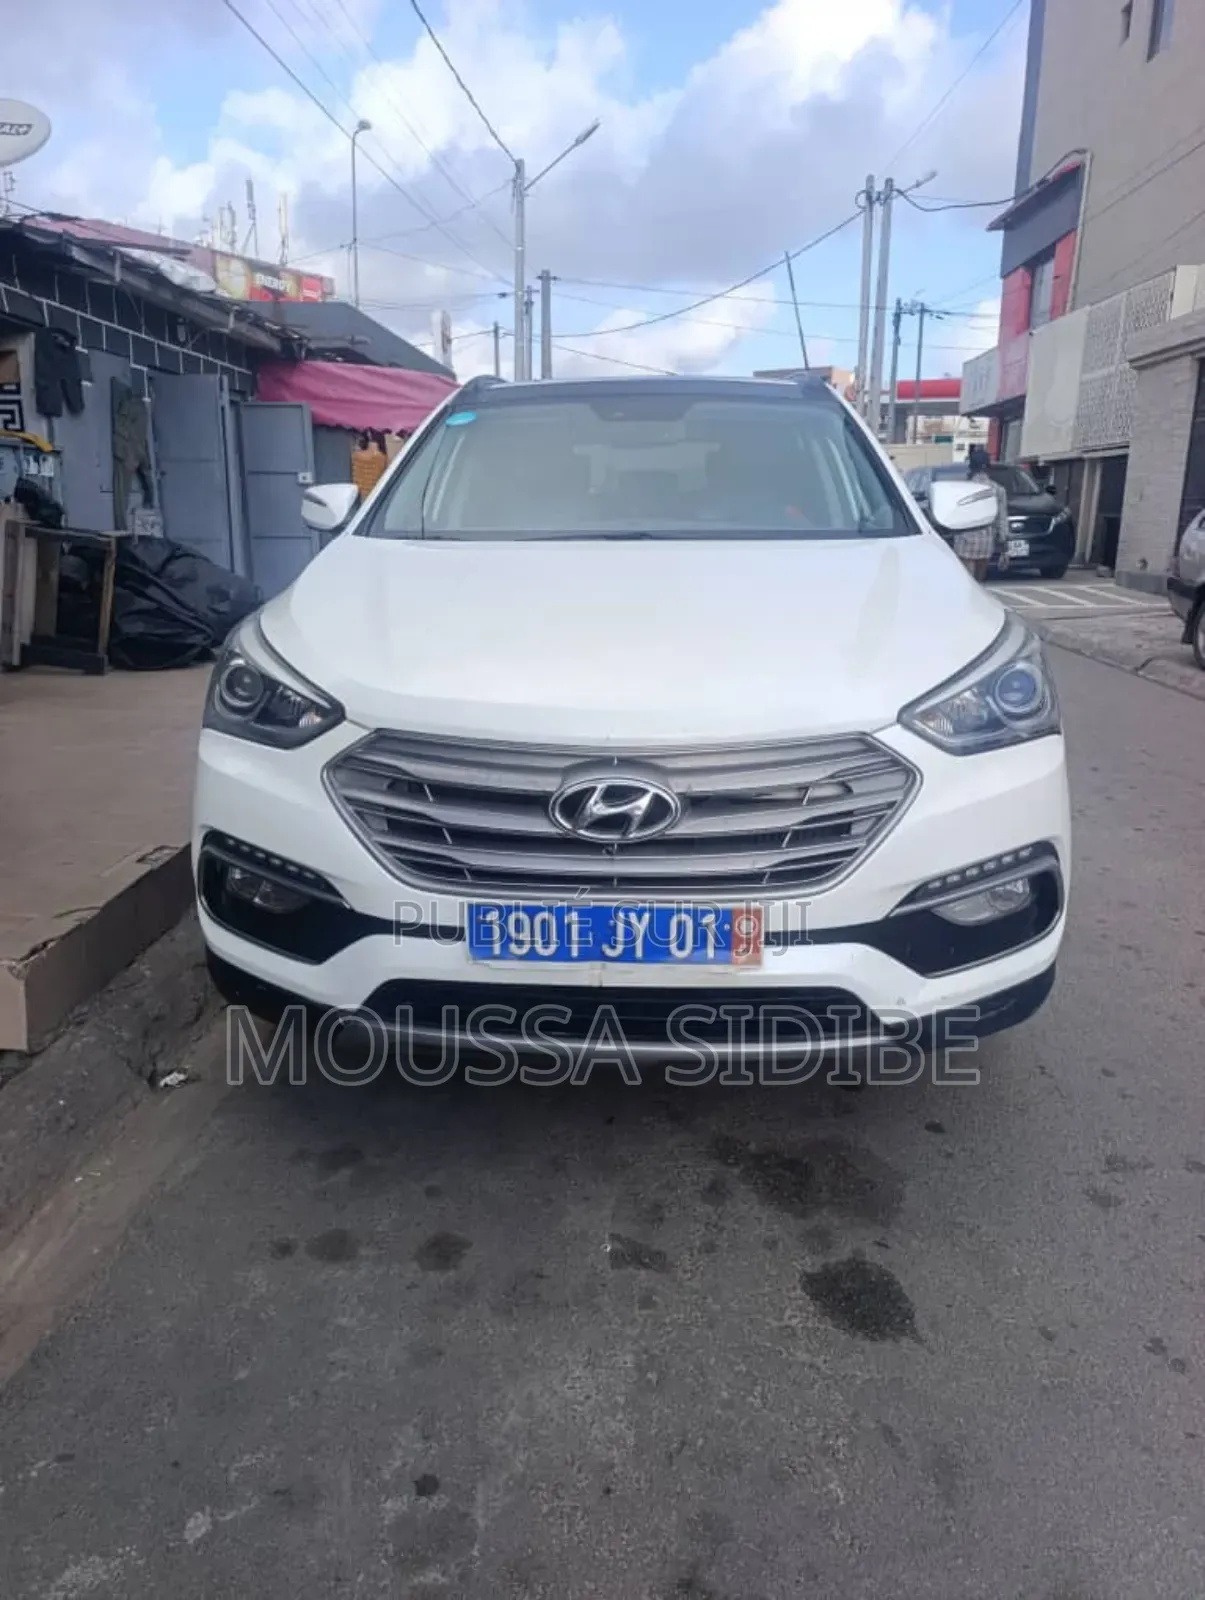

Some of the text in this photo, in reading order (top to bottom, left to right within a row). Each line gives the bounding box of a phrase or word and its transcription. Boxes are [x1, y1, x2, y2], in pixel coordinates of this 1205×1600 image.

[485, 911, 716, 959] 1901 JY 01
